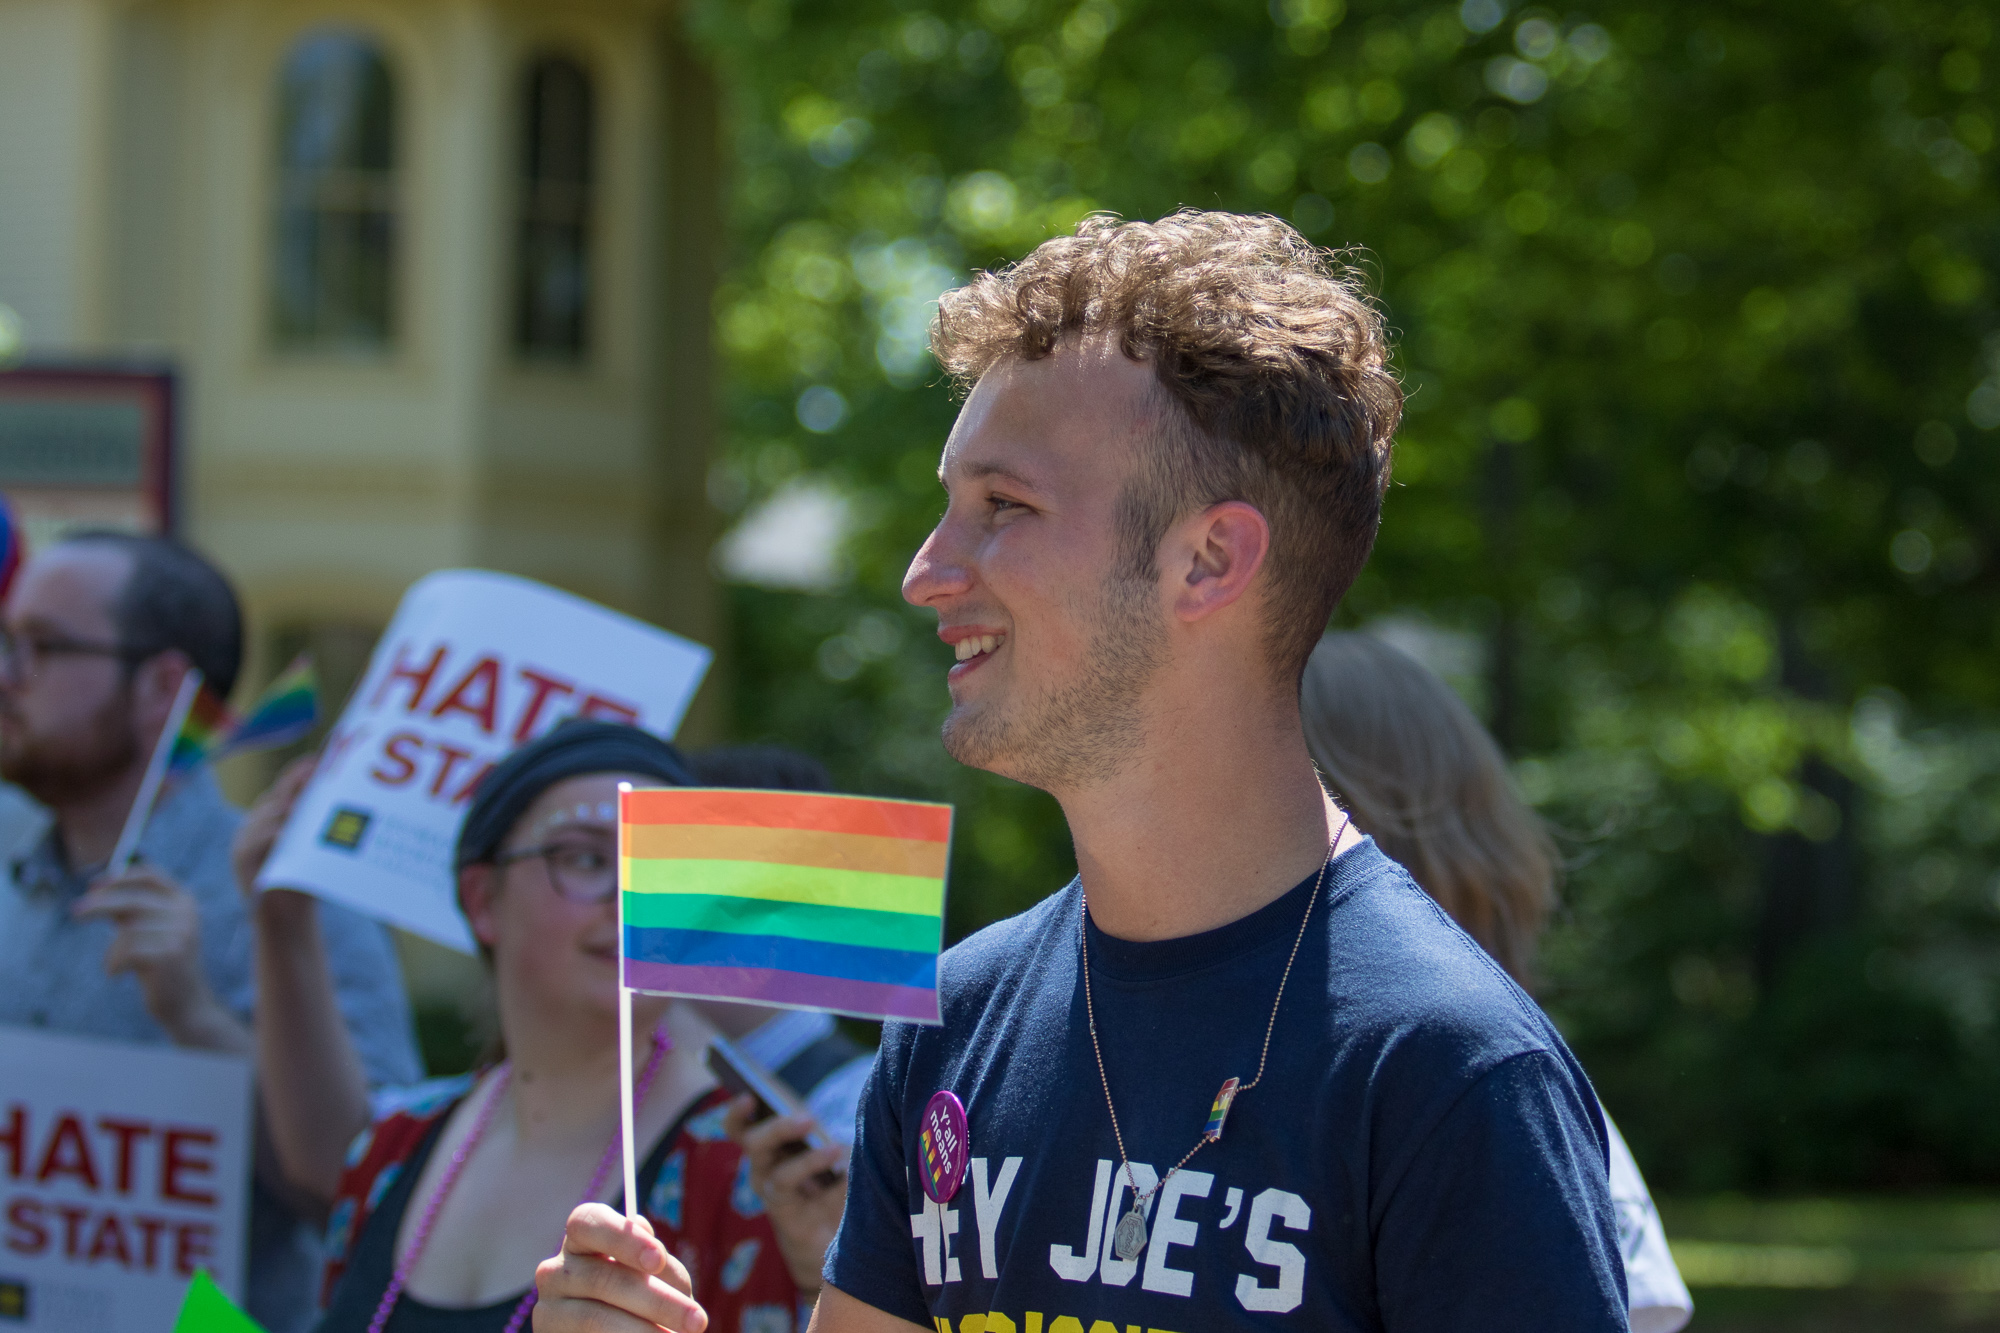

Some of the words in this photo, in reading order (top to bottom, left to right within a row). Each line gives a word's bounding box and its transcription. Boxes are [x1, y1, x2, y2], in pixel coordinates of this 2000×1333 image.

[369, 646, 640, 745] HAT
[919, 1128, 942, 1198] ALL
[930, 1110, 952, 1175] means
[940, 1105, 958, 1153] Y'all
[5, 1198, 217, 1278] STATE
[1049, 1158, 1312, 1314] JOE'S
